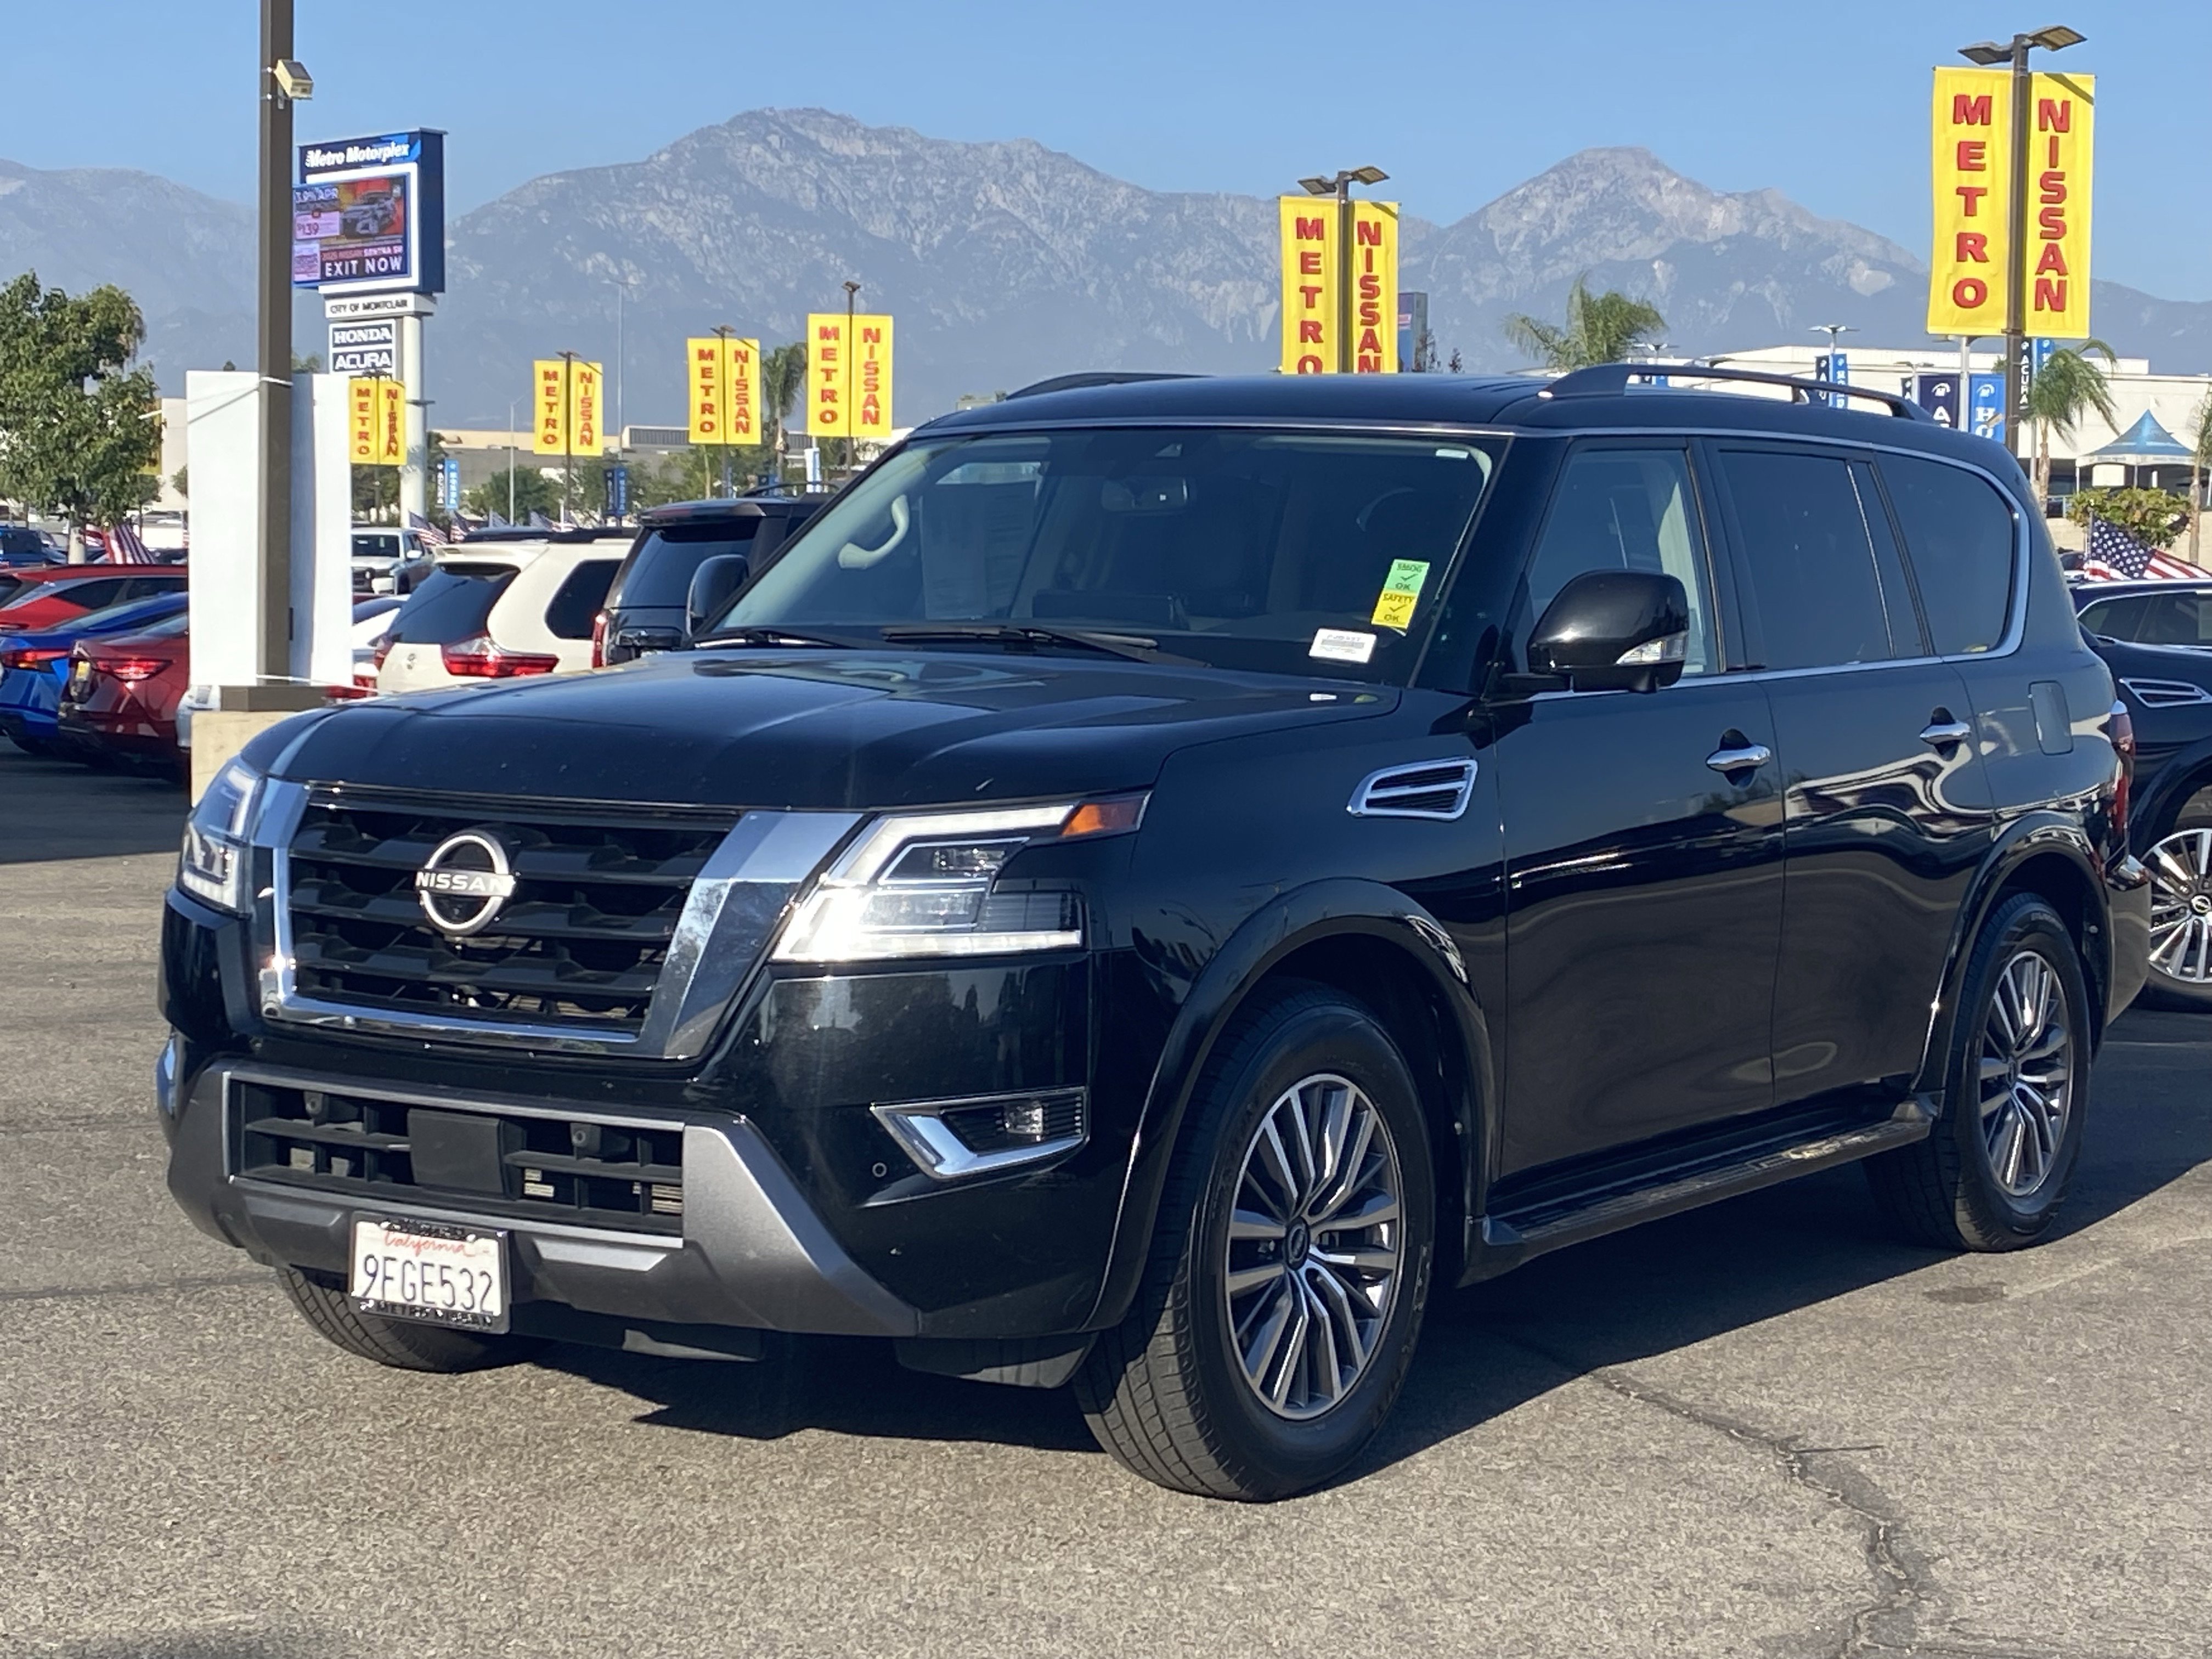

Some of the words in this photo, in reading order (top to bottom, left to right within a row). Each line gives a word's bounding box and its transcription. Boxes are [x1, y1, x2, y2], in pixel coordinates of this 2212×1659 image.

[1953, 94, 1992, 309] METRO
[2035, 99, 2070, 312] NISSAN
[325, 259, 358, 277] EXIT
[365, 256, 402, 274] NOW
[1296, 217, 1324, 374] METRO
[1357, 221, 1382, 374] NISSAN
[334, 328, 392, 344] HONDA
[349, 303, 359, 313] OF
[335, 351, 391, 370] ACURA
[697, 348, 715, 433] METRO
[735, 349, 750, 435] NISSAN
[819, 326, 840, 424] METRO
[862, 328, 881, 425] NISSAN
[2019, 354, 2029, 404] ACURA
[357, 387, 371, 455] METRO
[386, 388, 398, 456] NISSAN
[543, 369, 558, 445] METRO
[579, 371, 592, 446] NISSAN
[1384, 614, 1400, 622] OK
[1395, 582, 1411, 590] OK
[415, 871, 508, 892] NISSAN
[383, 1231, 475, 1256] California
[362, 1254, 493, 1316] 9FGE532
